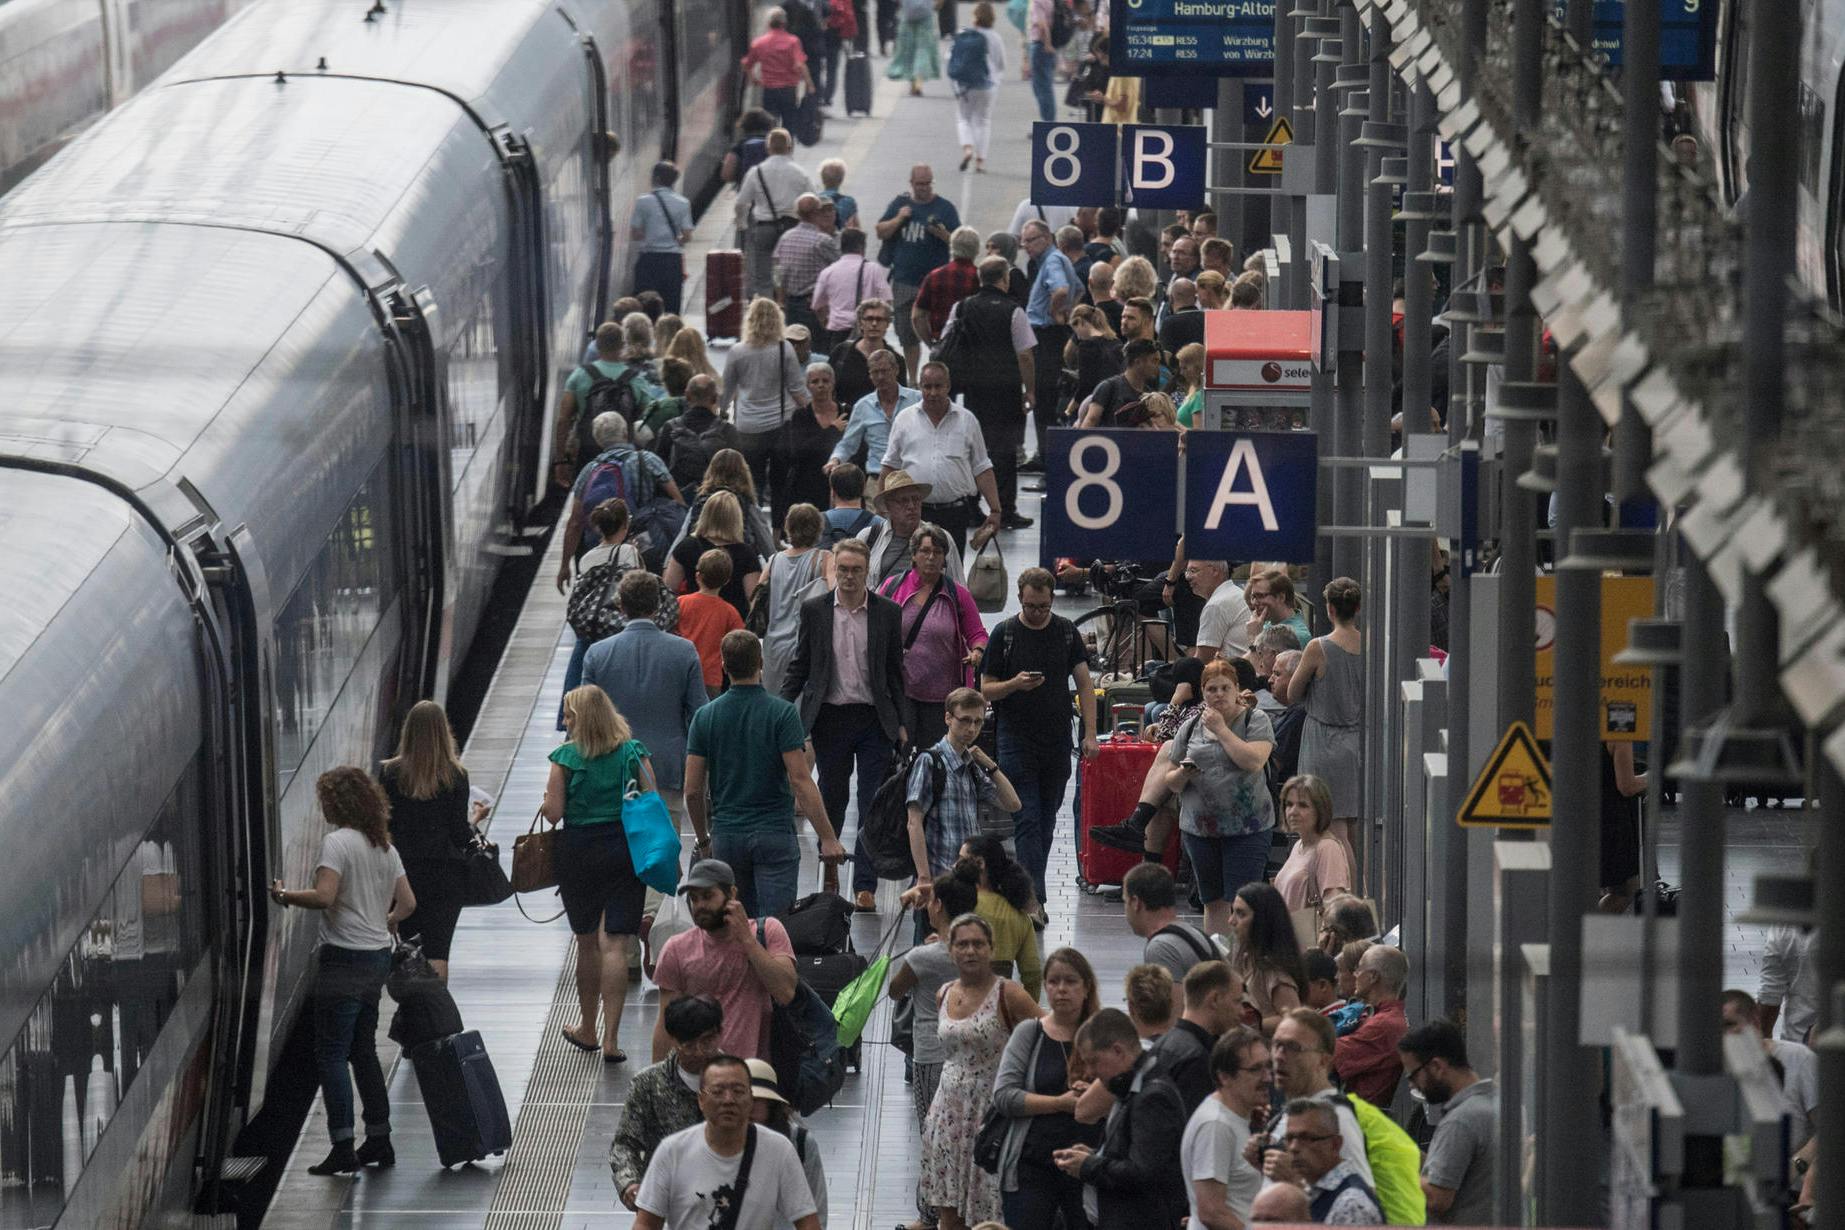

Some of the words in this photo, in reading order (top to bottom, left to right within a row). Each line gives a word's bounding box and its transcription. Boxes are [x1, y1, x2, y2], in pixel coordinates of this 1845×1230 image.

[1223, 36, 1269, 48] Würzburg
[1223, 51, 1240, 59] von
[1043, 126, 1081, 187] 8
[1133, 129, 1175, 189] B
[1284, 367, 1311, 378] sele
[1065, 434, 1124, 530] 8
[1203, 437, 1279, 532] A
